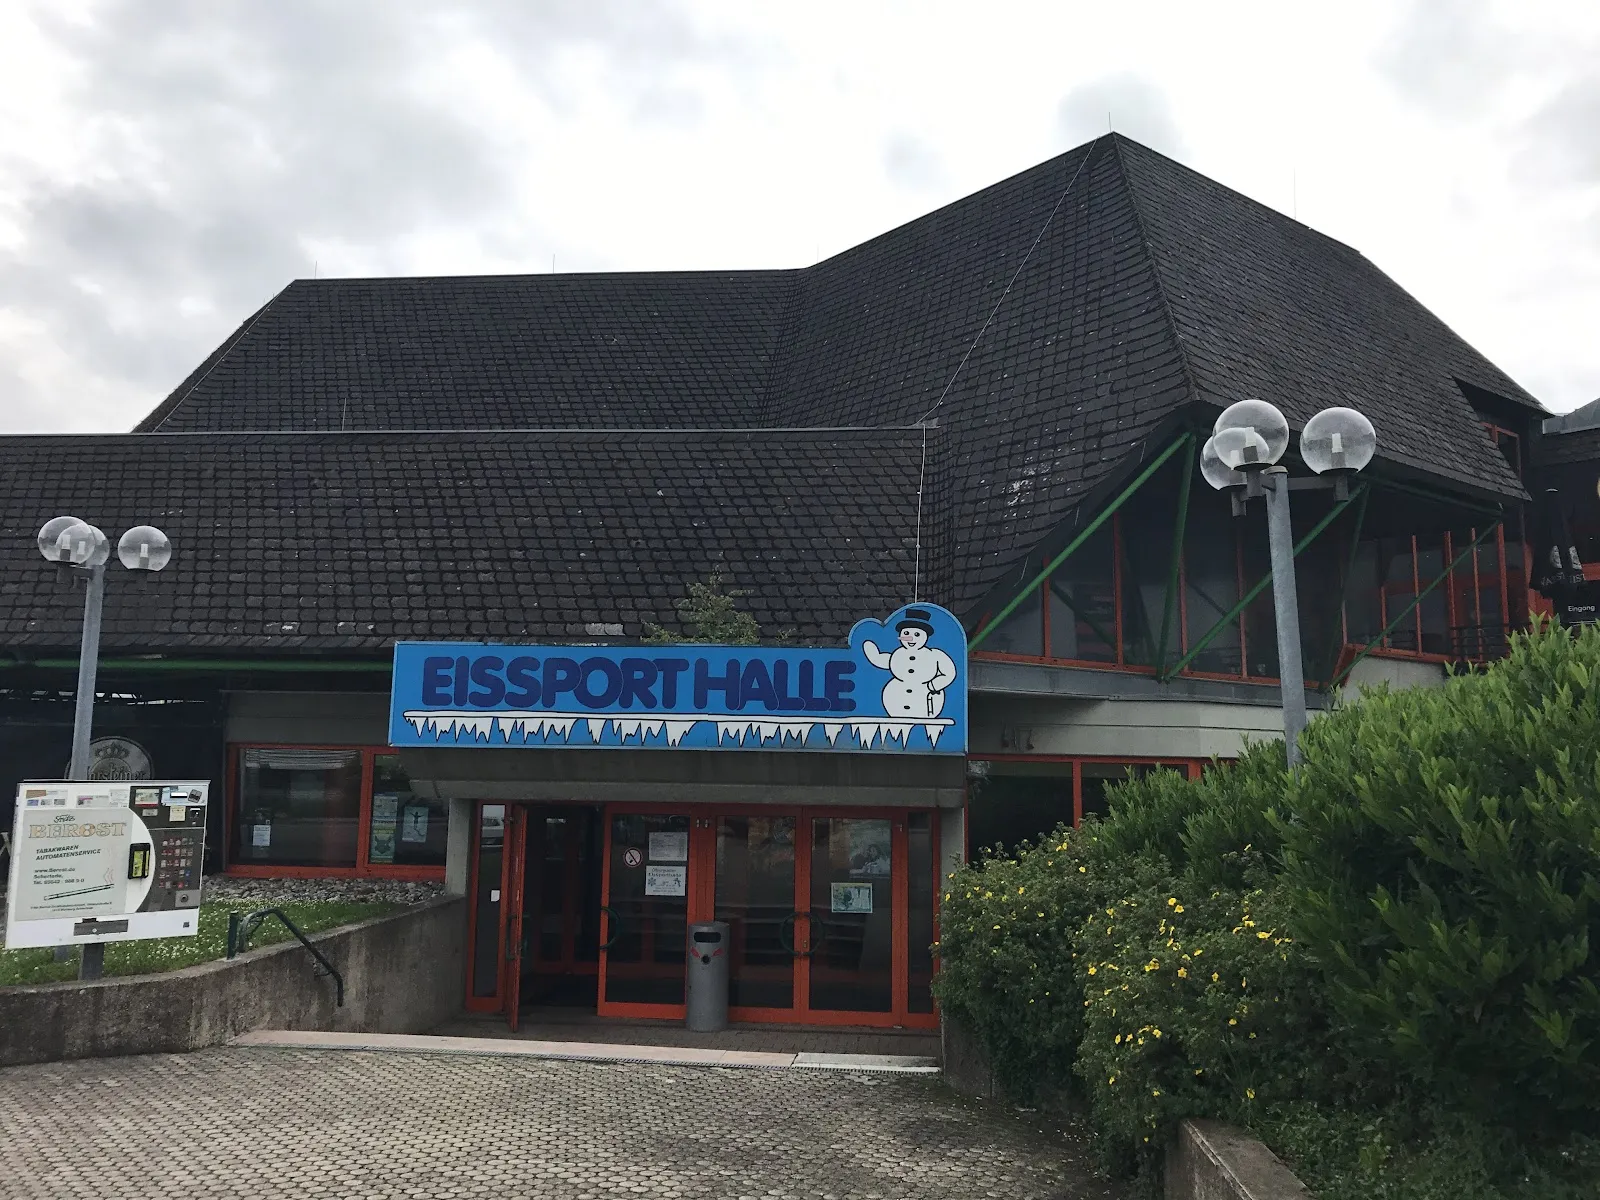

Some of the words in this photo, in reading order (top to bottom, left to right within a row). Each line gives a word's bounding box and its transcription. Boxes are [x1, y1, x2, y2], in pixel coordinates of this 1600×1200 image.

[1567, 605, 1596, 613] Eingang
[28, 822, 127, 839] BEROST
[36, 845, 79, 854] TABAKWAREN
[36, 848, 101, 861] AUTOMATENSERVICE
